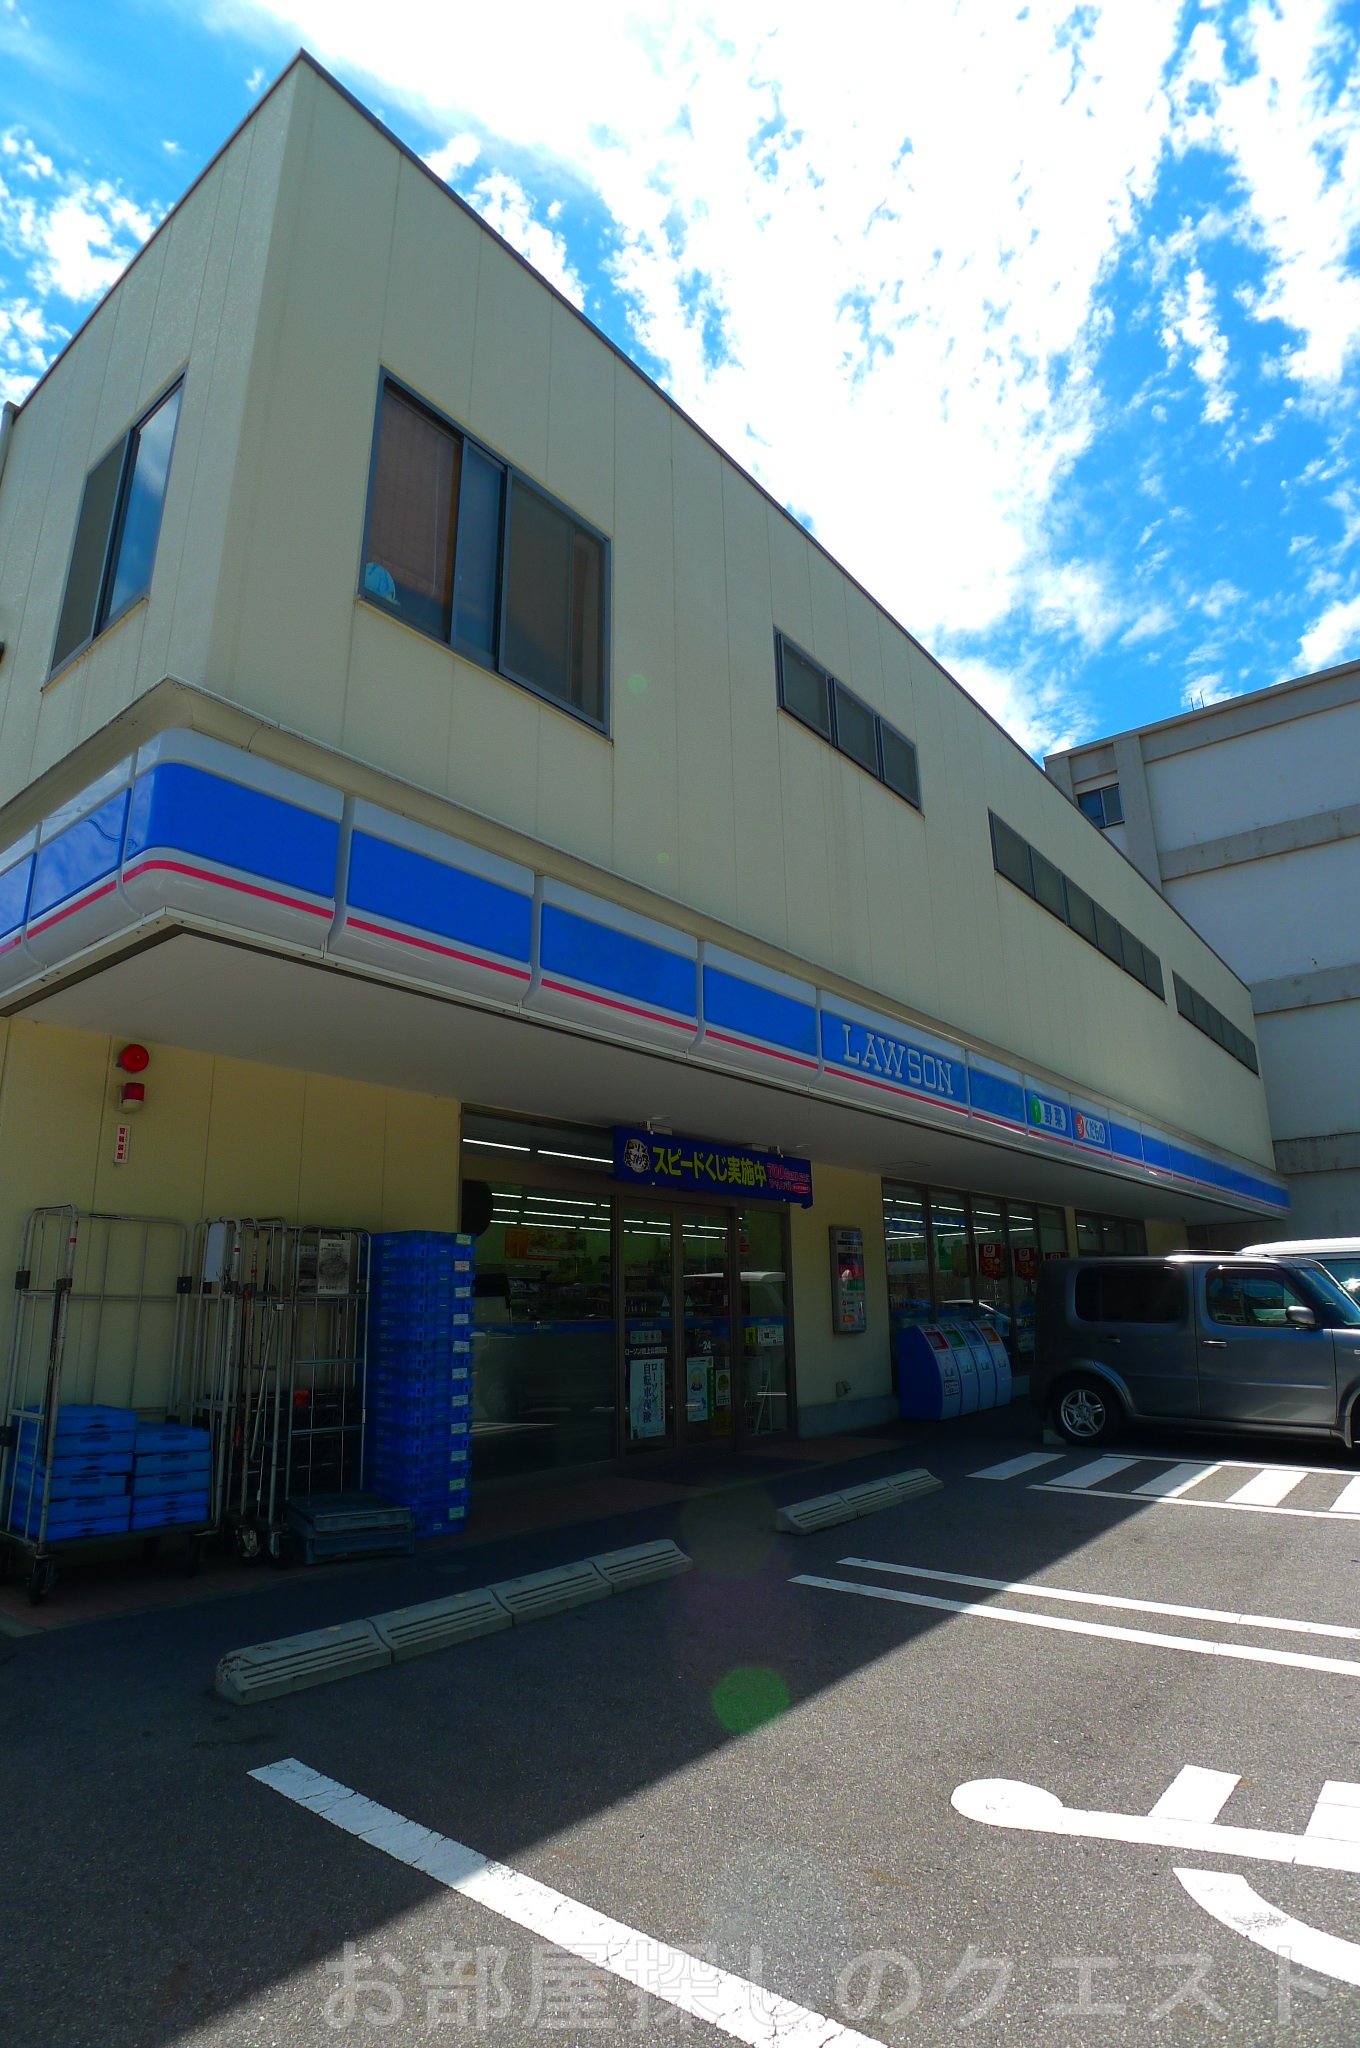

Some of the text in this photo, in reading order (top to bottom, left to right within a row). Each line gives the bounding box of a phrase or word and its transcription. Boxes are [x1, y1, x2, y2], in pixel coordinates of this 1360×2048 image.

[842, 1023, 954, 1095] LAWSON
[1043, 1103, 1064, 1129] 野菜
[1085, 1118, 1105, 1143] くだもの
[652, 1146, 767, 1187] スピードくじ実施中
[643, 1362, 651, 1423] 自転車保険
